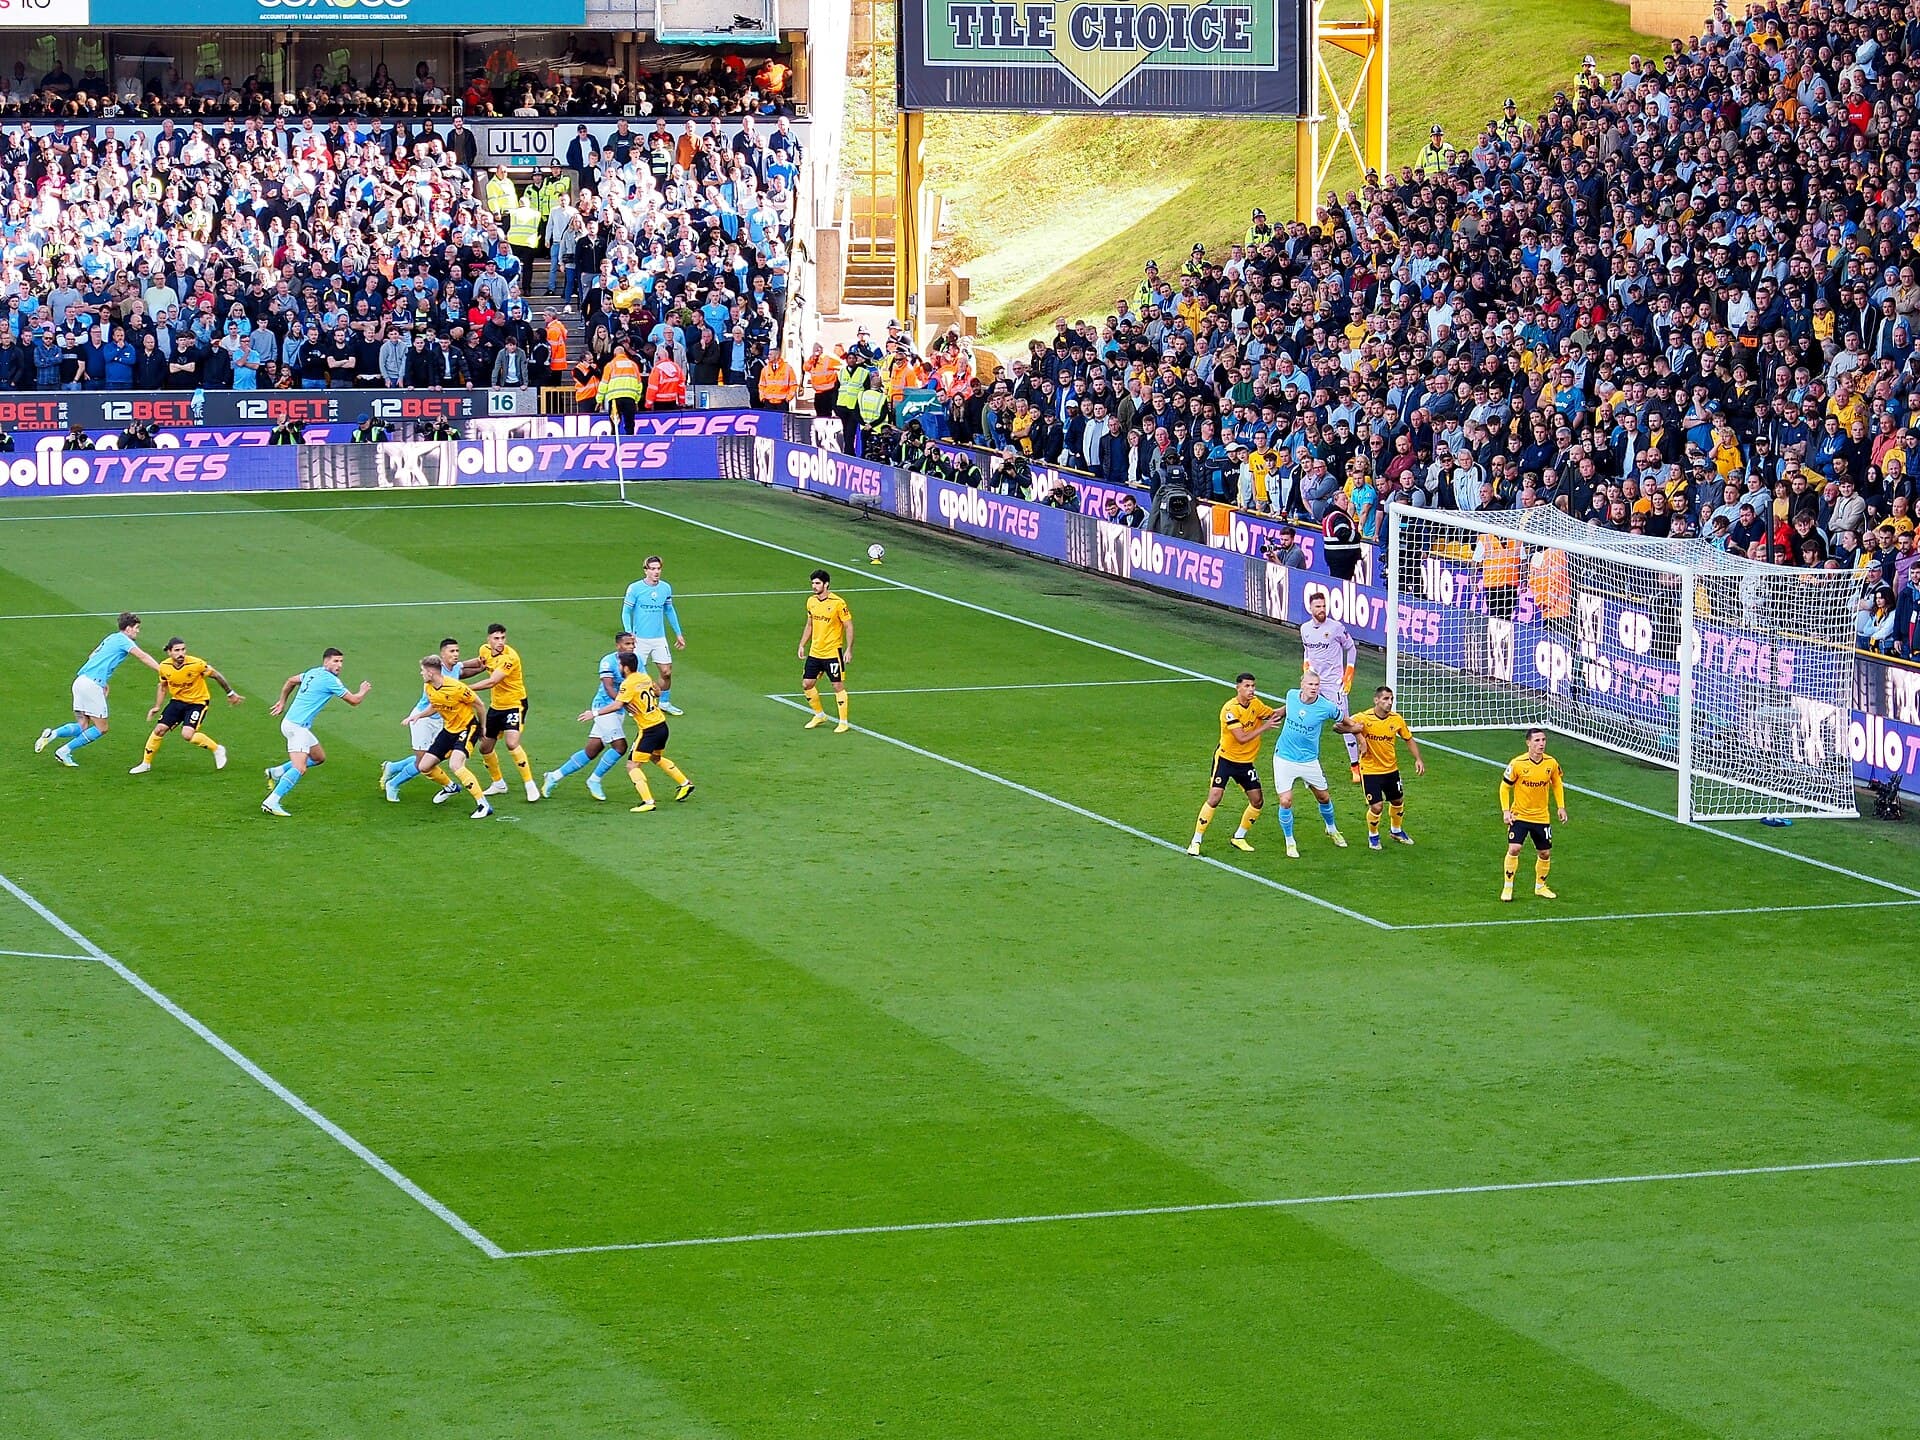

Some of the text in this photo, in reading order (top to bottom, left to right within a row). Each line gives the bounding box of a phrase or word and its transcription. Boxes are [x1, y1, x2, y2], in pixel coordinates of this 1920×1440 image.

[948, 3, 1251, 52] TILE CHOICE
[496, 131, 547, 153] JL10
[101, 401, 191, 420] 12BET
[236, 400, 328, 419] 12BET
[371, 398, 462, 417] 12BET
[491, 395, 514, 410] 16
[537, 442, 672, 471] TYRES
[0, 450, 230, 487] ollo TYRES
[787, 447, 881, 496] apollo TYRES
[939, 486, 1040, 540] apollo TYRES
[1164, 545, 1224, 590] TYRES
[830, 662, 839, 674] 17
[190, 710, 200, 721] 8
[506, 713, 520, 724] 23
